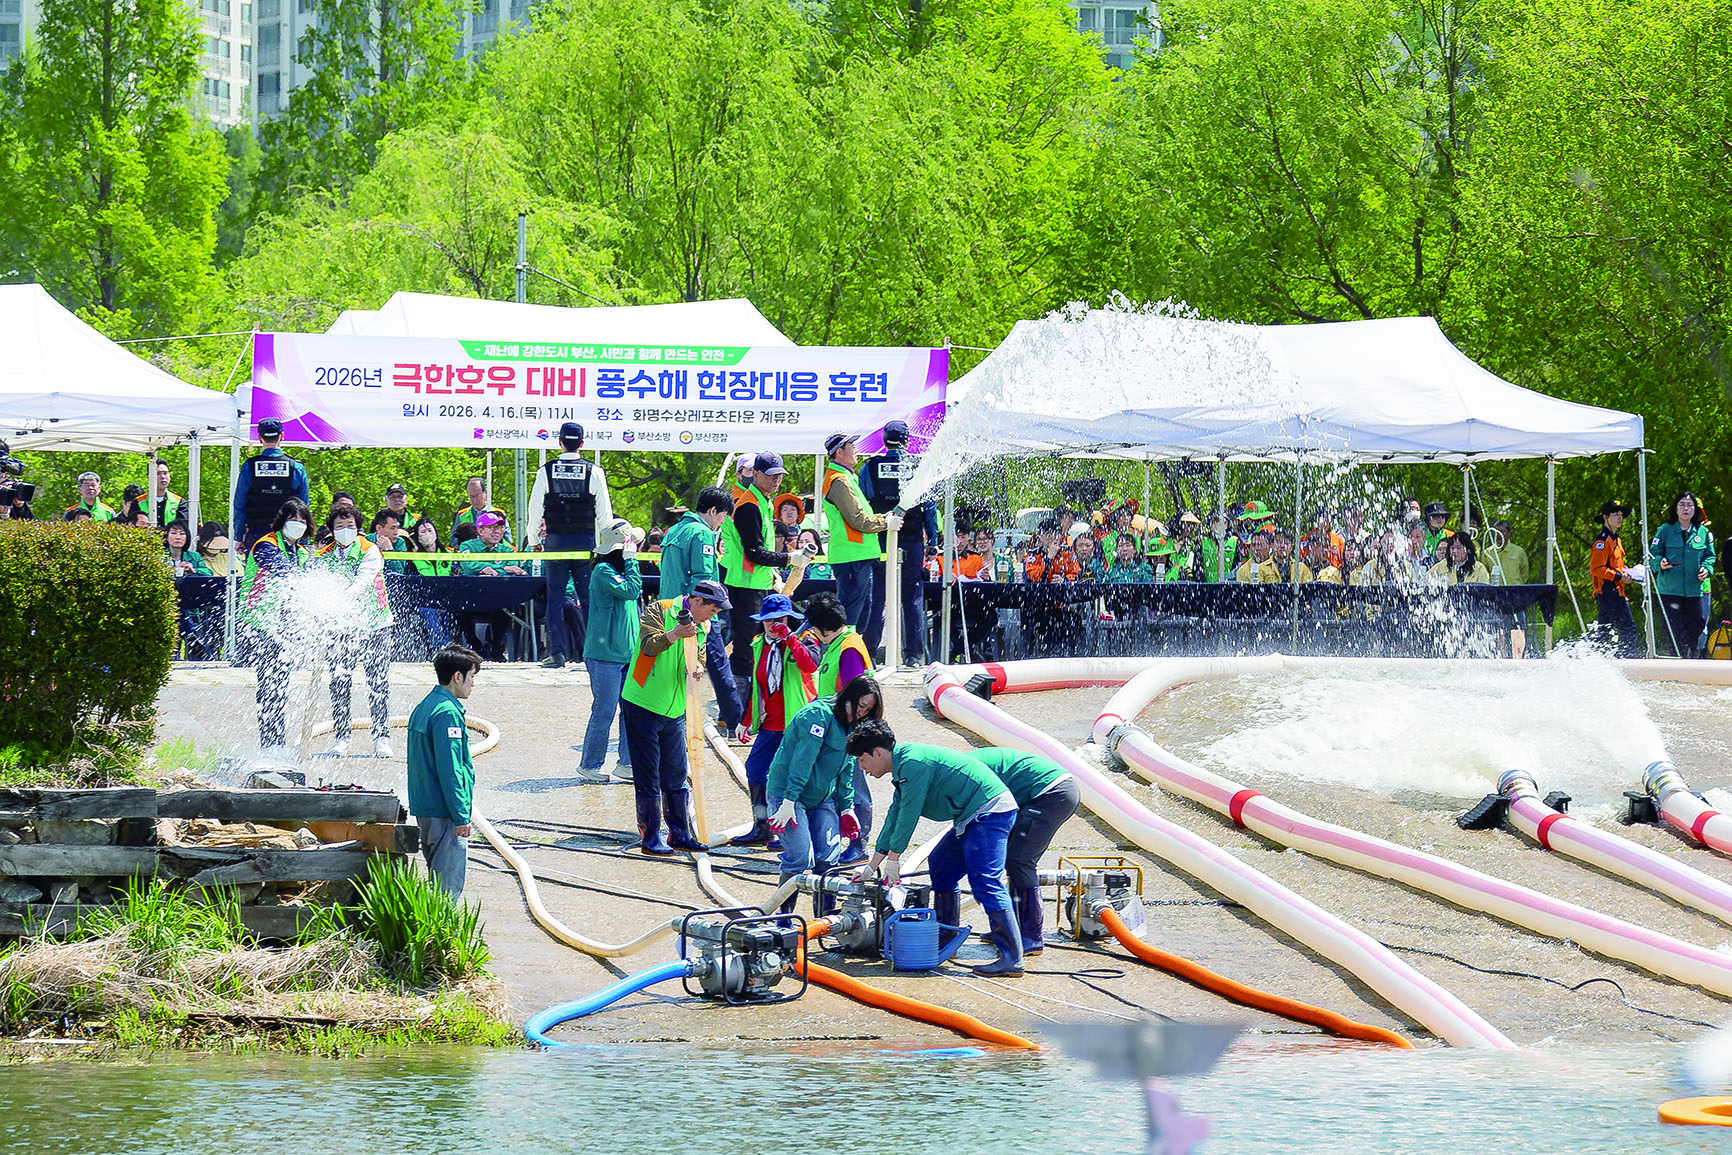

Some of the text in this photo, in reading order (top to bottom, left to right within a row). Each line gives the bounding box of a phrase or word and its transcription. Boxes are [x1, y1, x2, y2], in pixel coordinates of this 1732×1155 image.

[484, 344, 519, 357] 재난에
[522, 345, 569, 358] 강한도시
[600, 347, 636, 360] 시민과
[638, 348, 661, 361] 함께
[664, 348, 698, 361] 만드는
[701, 349, 725, 361] 안전
[315, 363, 888, 402] 2026년 극한호우 대비 풍수해 현장대응 훈련
[402, 403, 429, 417] 일시
[439, 404, 477, 418] 2026.
[482, 406, 494, 419] 4.
[548, 407, 574, 420] 11시
[596, 407, 801, 424] 장소 화명수상레포츠타운 계류장
[486, 428, 529, 440] 부산광역시
[596, 430, 613, 440] 북구
[637, 430, 671, 442] 부산소방
[694, 432, 728, 443] 부산경찰
